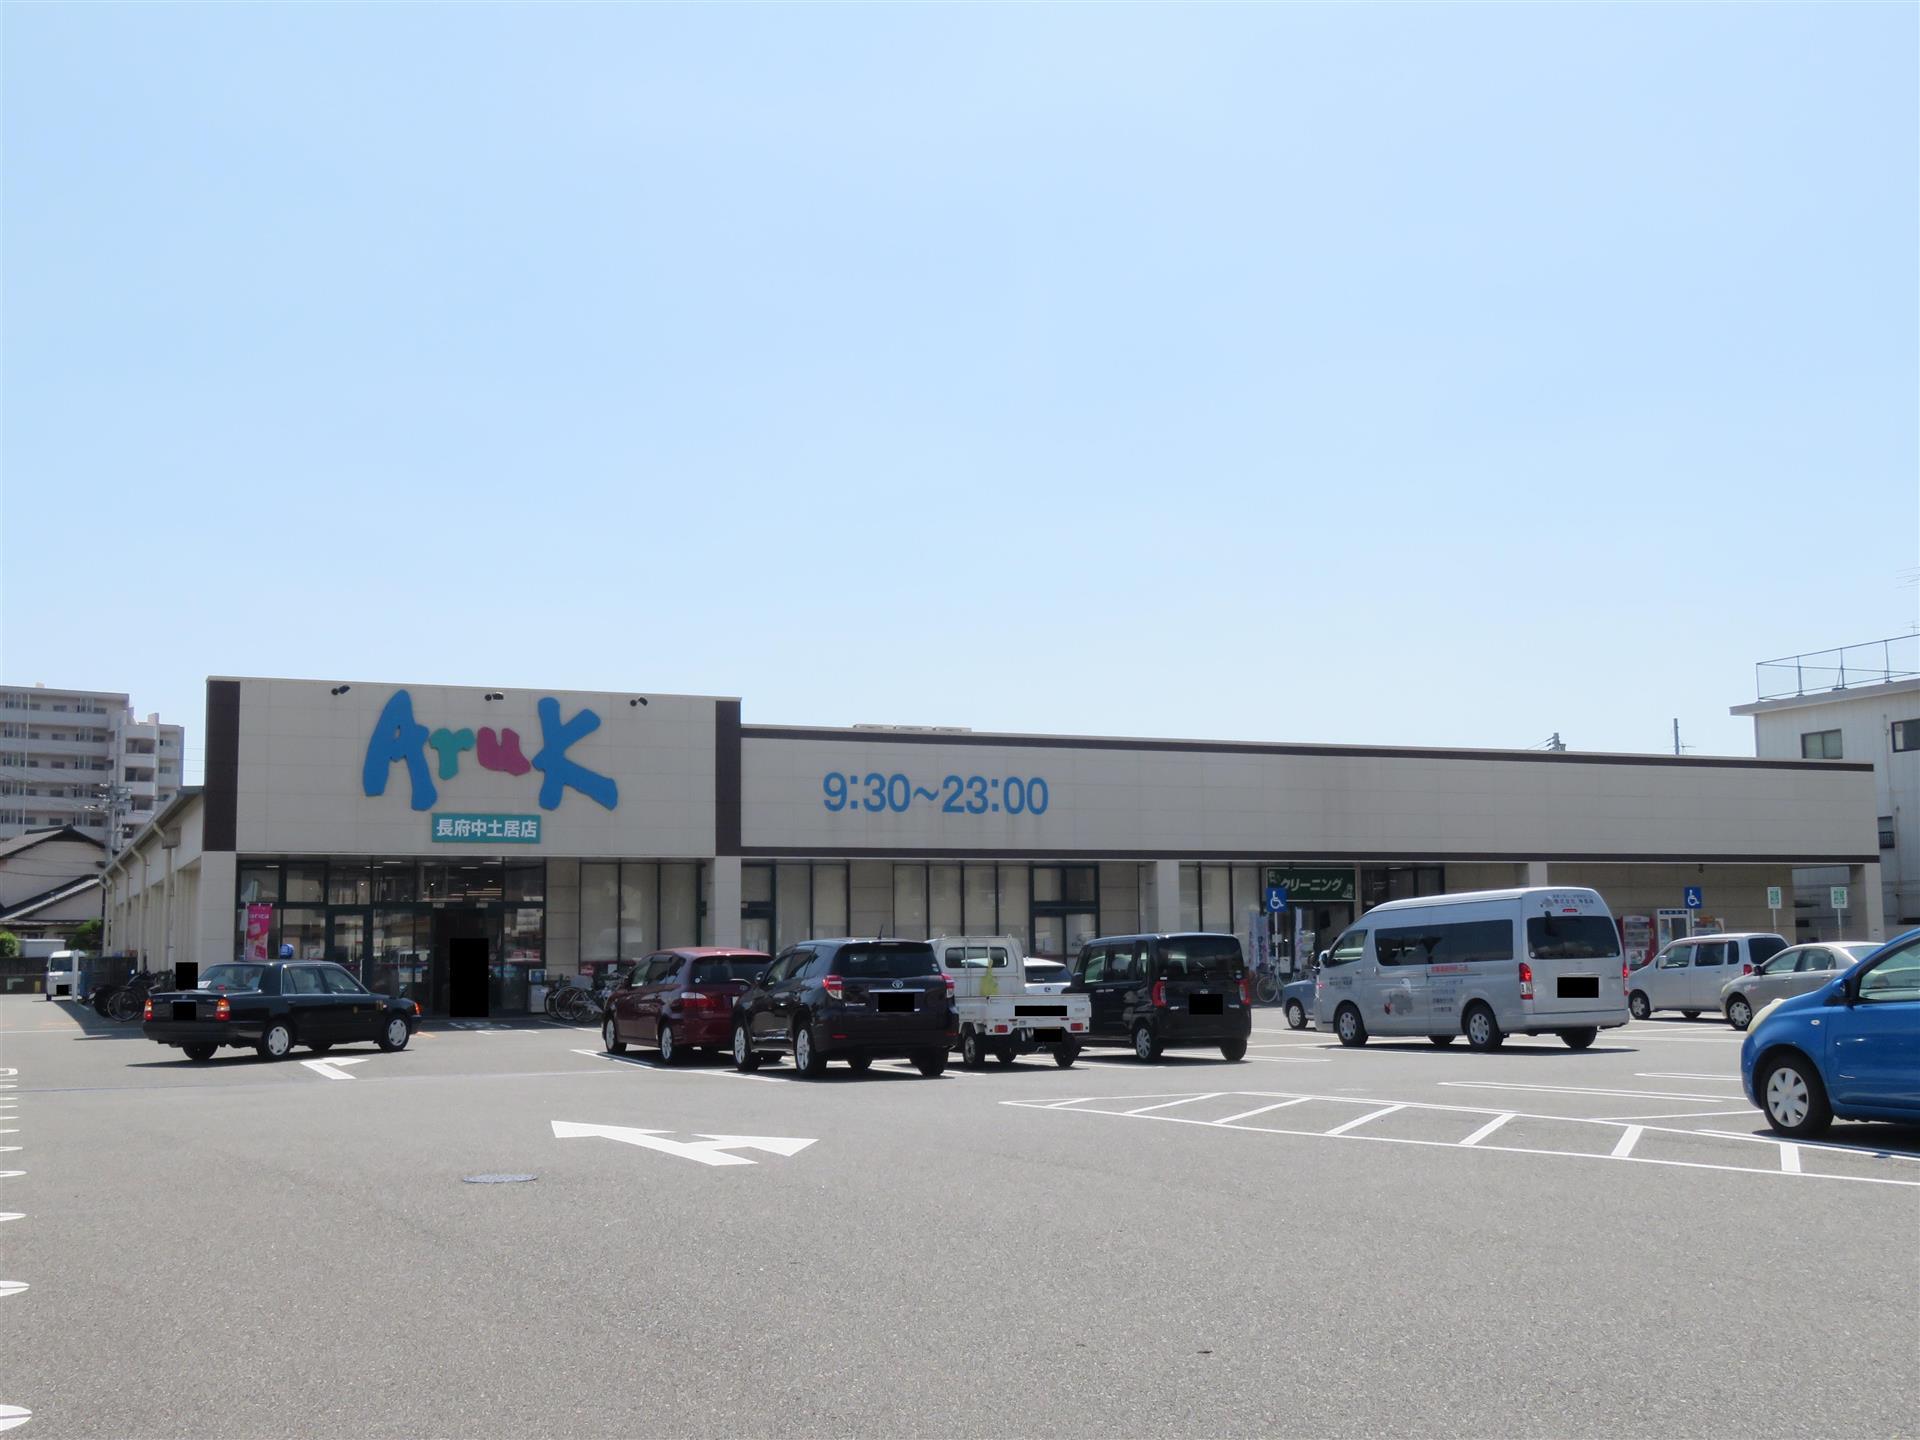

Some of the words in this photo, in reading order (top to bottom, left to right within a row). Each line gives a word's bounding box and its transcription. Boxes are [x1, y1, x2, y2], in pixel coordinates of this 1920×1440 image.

[436, 818, 538, 839] 長府中土居店
[1280, 877, 1343, 892] クリーニング
